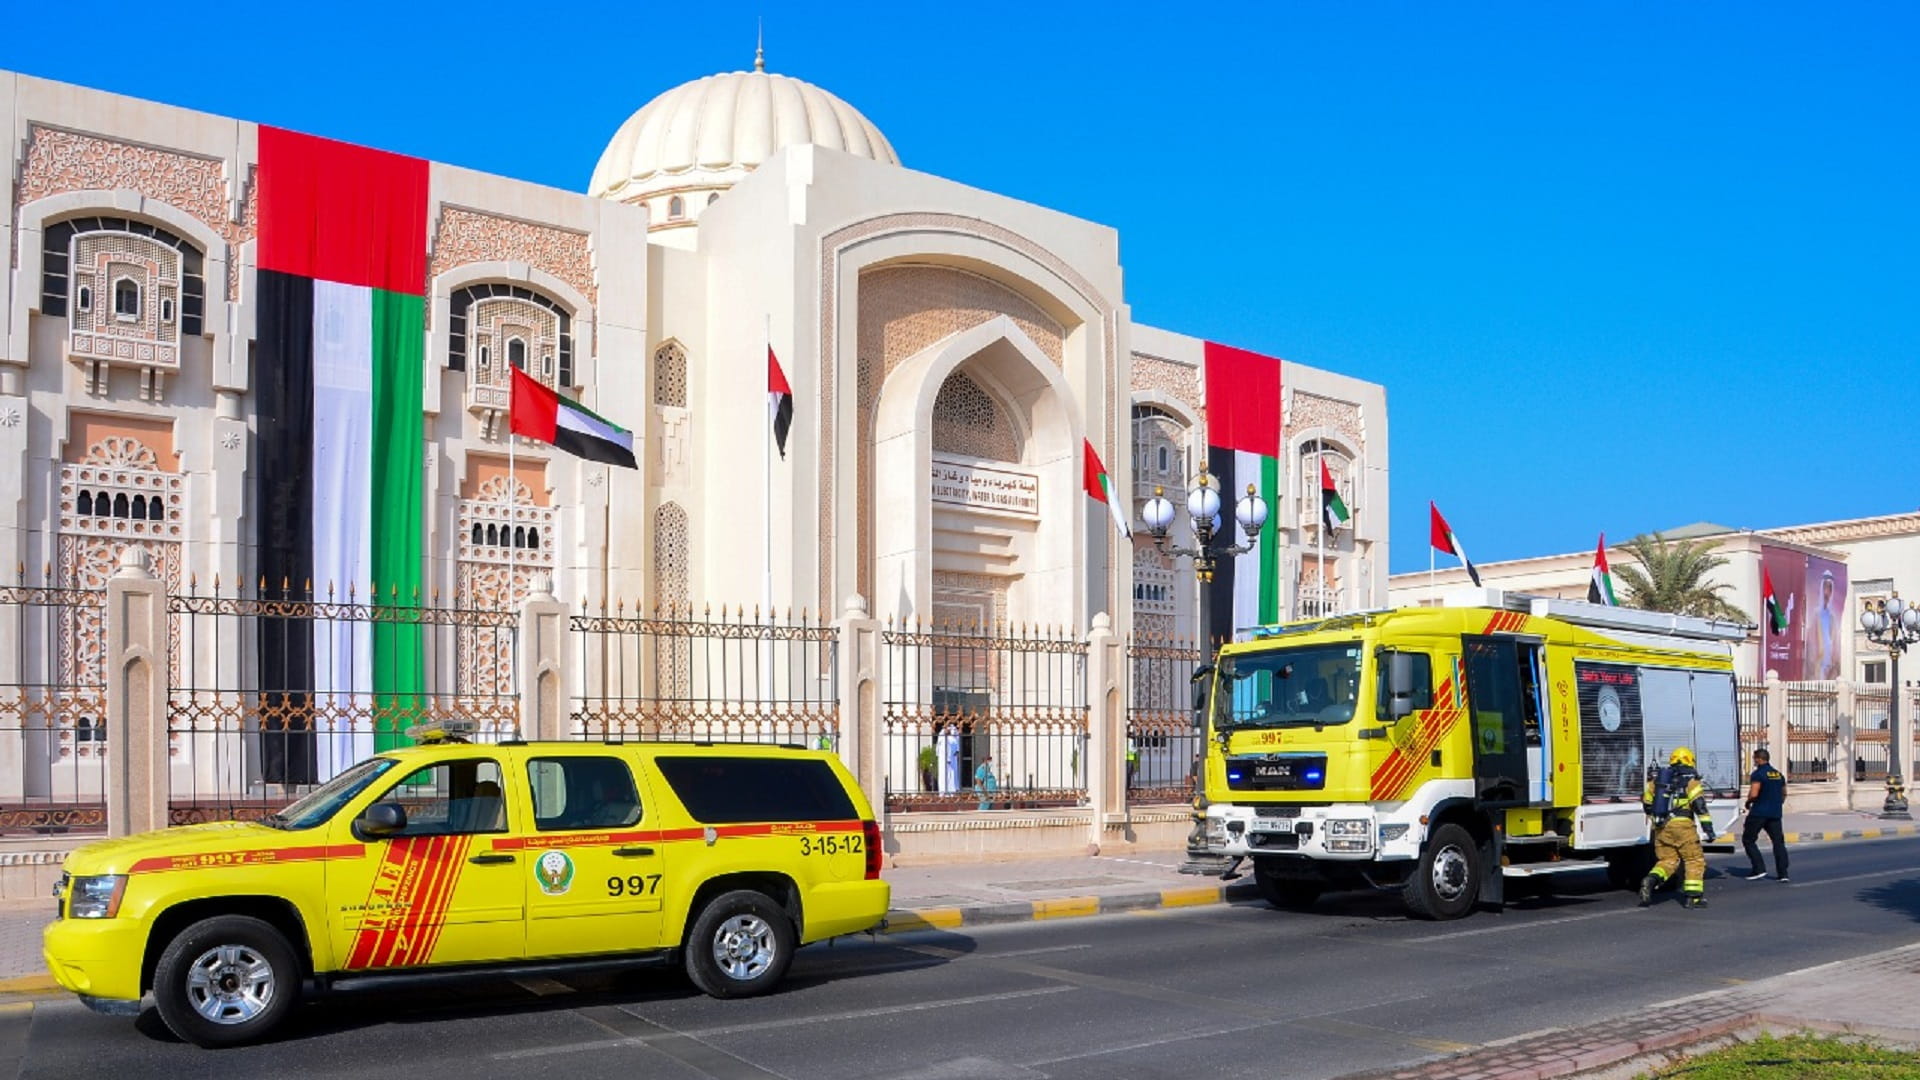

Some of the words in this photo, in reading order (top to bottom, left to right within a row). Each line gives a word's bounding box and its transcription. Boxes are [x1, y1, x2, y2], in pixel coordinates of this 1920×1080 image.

[1261, 732, 1282, 745] 997
[1255, 766, 1291, 776] MAN
[800, 835, 862, 856] 3-15-12
[200, 851, 247, 866] 997
[607, 874, 663, 897] 997
